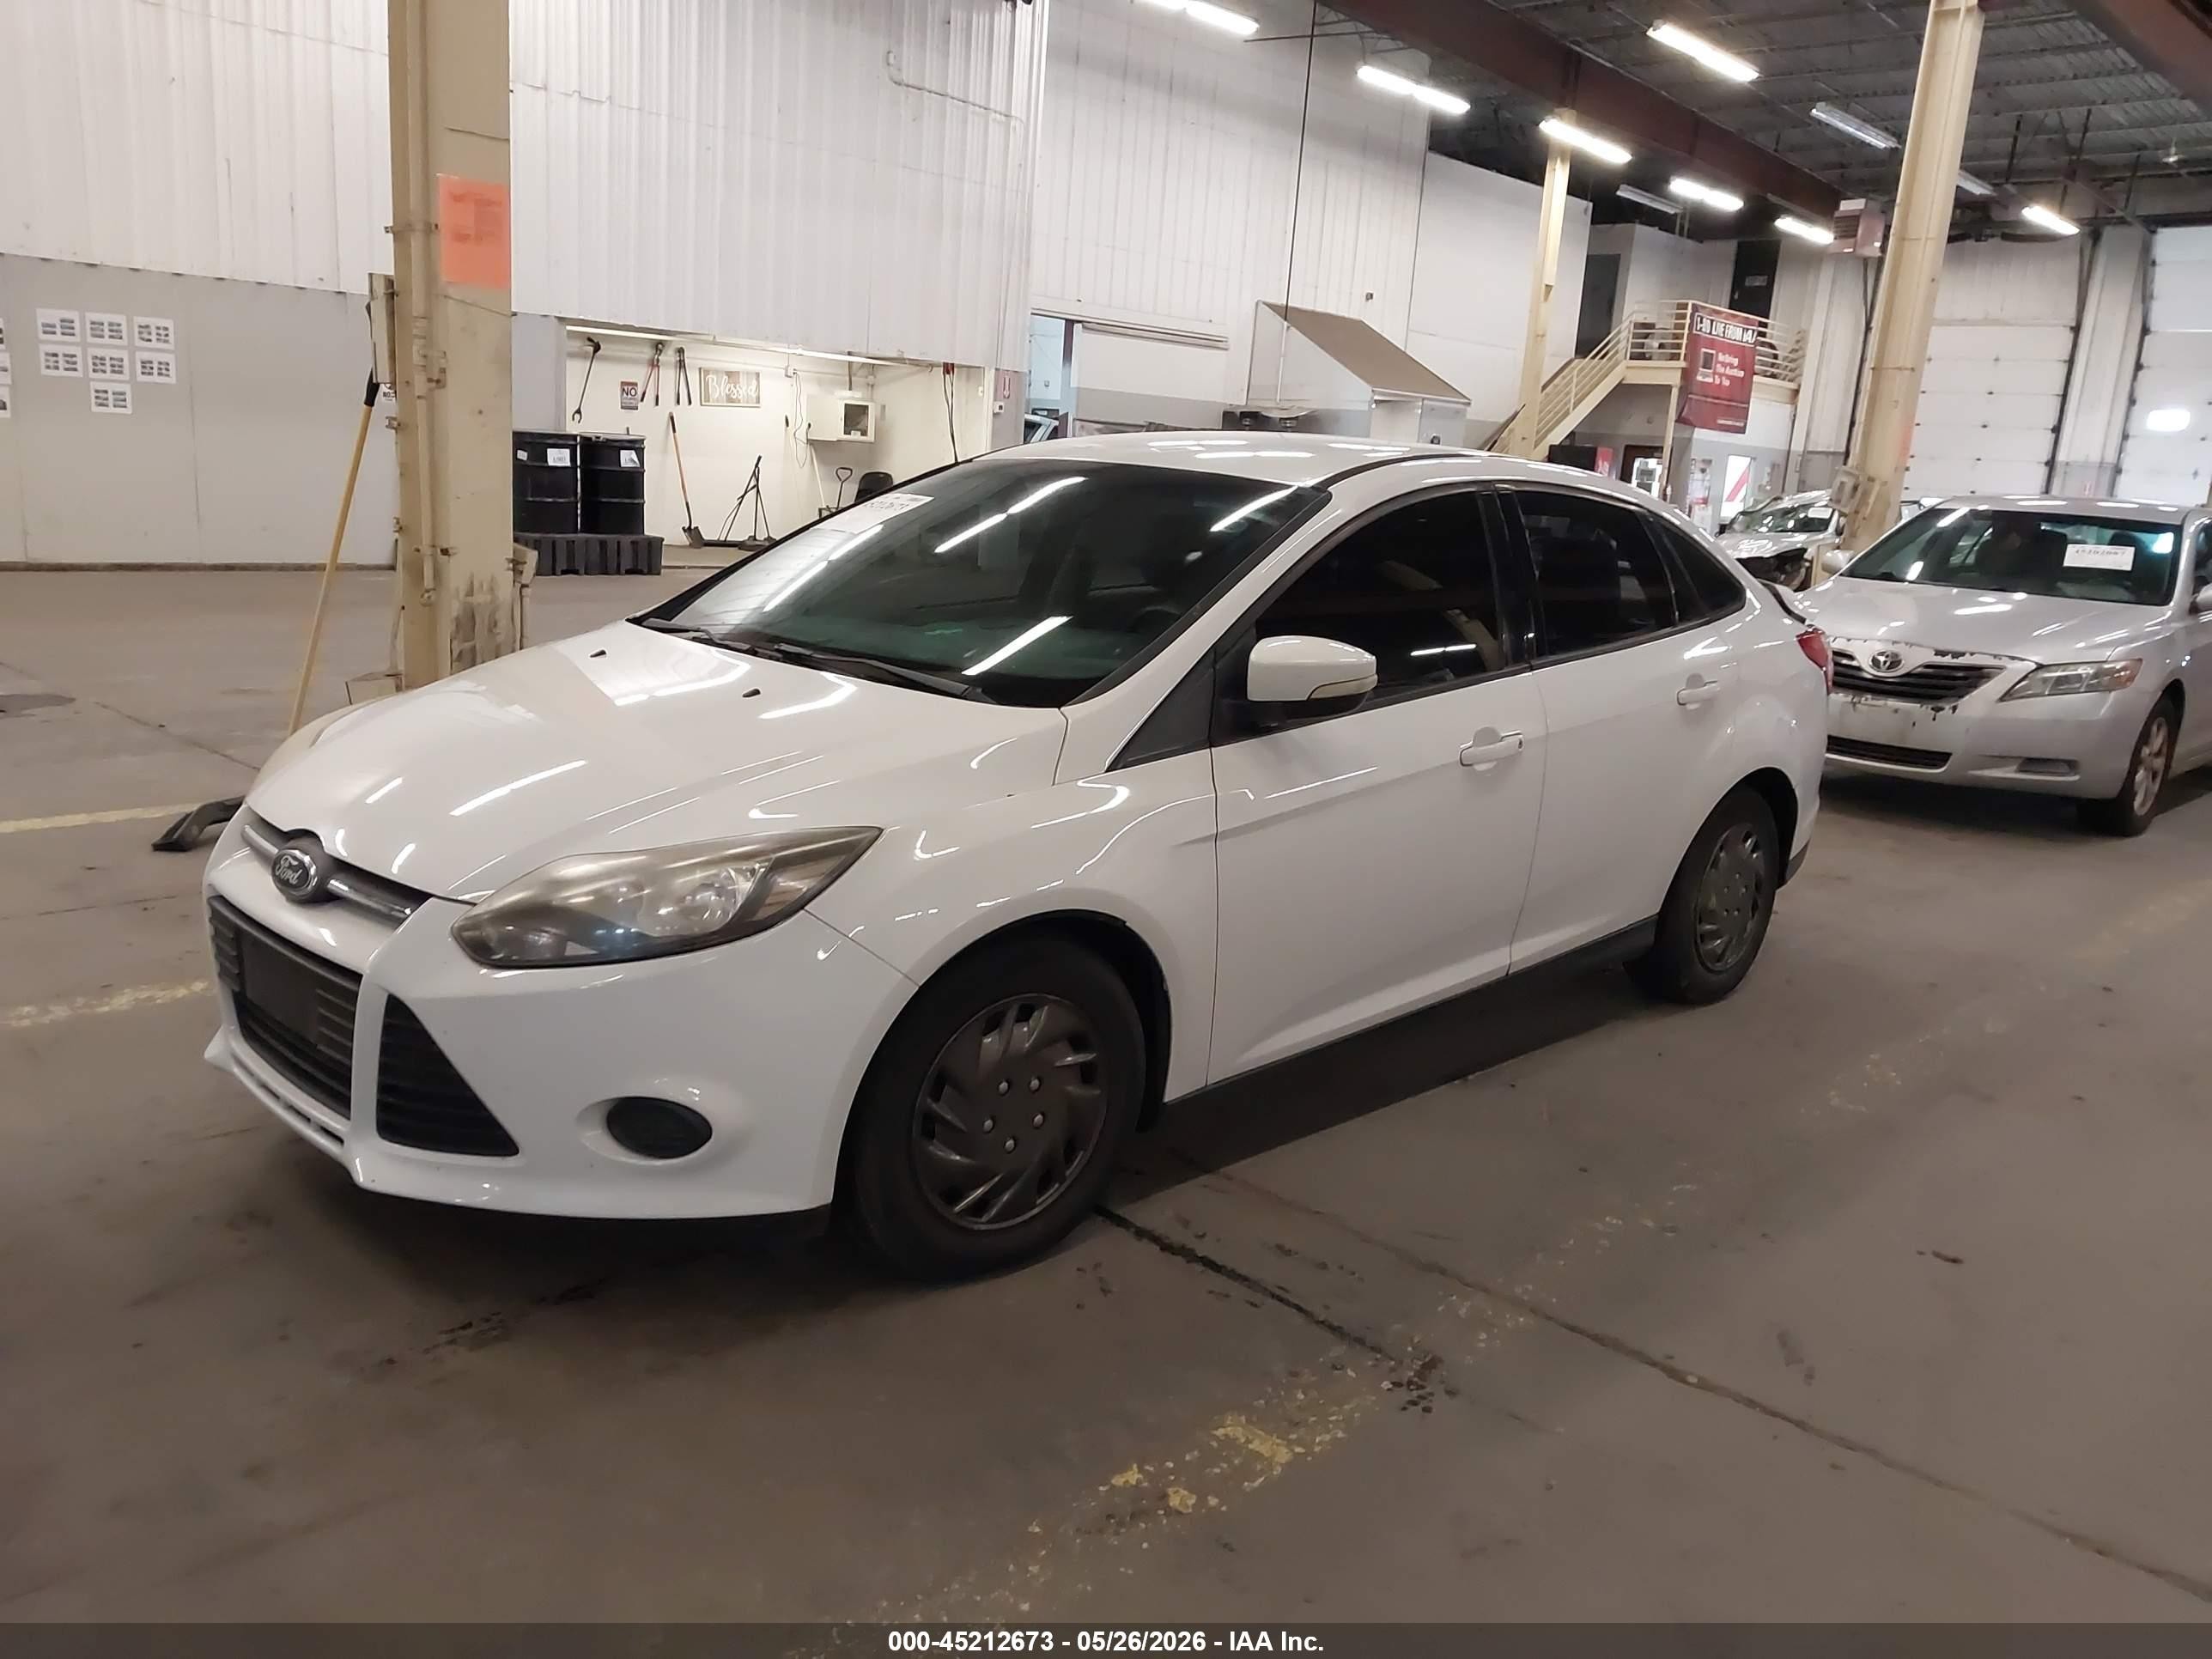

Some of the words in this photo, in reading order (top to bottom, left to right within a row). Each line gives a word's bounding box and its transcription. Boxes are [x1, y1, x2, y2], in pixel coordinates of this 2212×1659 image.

[623, 386, 637, 398] NO
[706, 374, 758, 398] Blessed
[275, 854, 303, 884] Ford
